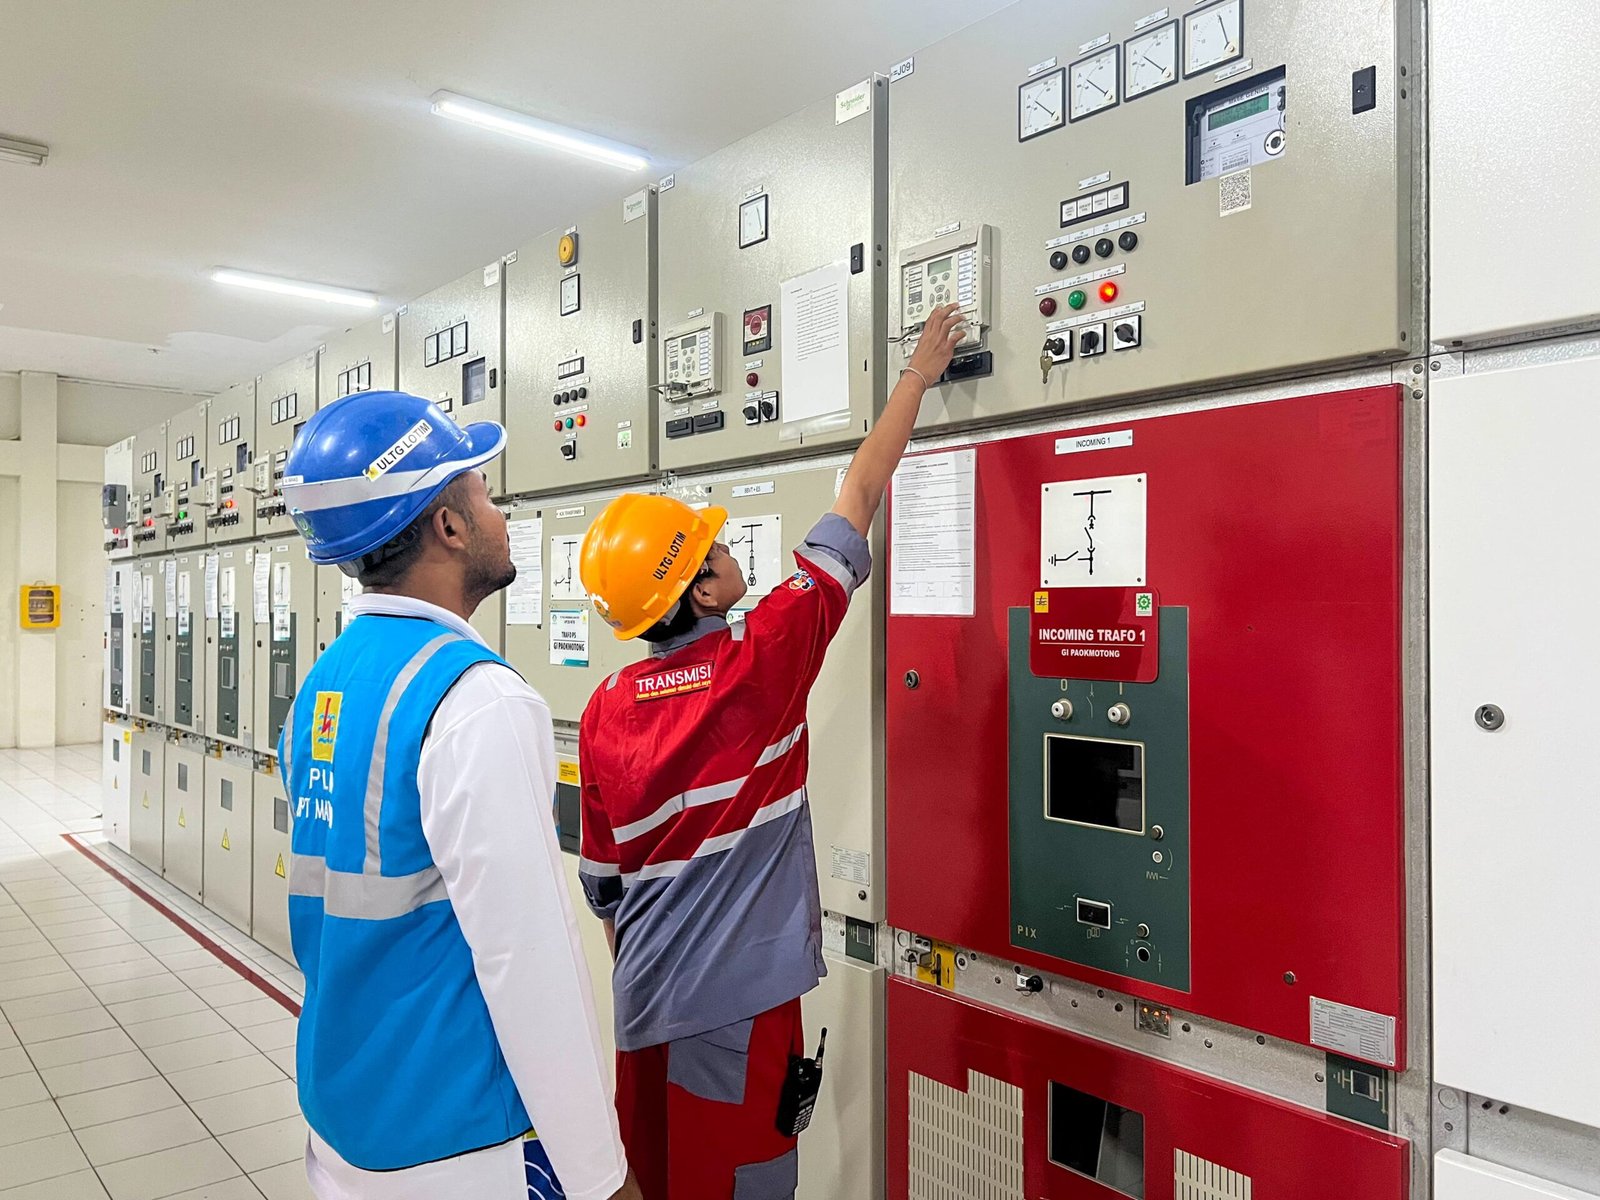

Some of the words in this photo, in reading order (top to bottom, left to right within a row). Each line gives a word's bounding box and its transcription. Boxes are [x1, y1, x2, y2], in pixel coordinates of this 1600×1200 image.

[376, 445, 405, 471] ULTG
[402, 422, 430, 450] LOTIM
[1076, 438, 1106, 448] INCOMING
[1107, 437, 1111, 445] 1
[653, 557, 673, 580] ULTG
[669, 531, 687, 558] LOTIM
[1039, 628, 1094, 642] INCOMING
[1097, 629, 1136, 642] TRAFO
[1139, 630, 1145, 642] 1
[1061, 648, 1069, 656] GI
[1070, 649, 1120, 658] PAOKMOTONG
[635, 665, 711, 692] TRANSMISI
[1017, 925, 1037, 939] PIX
